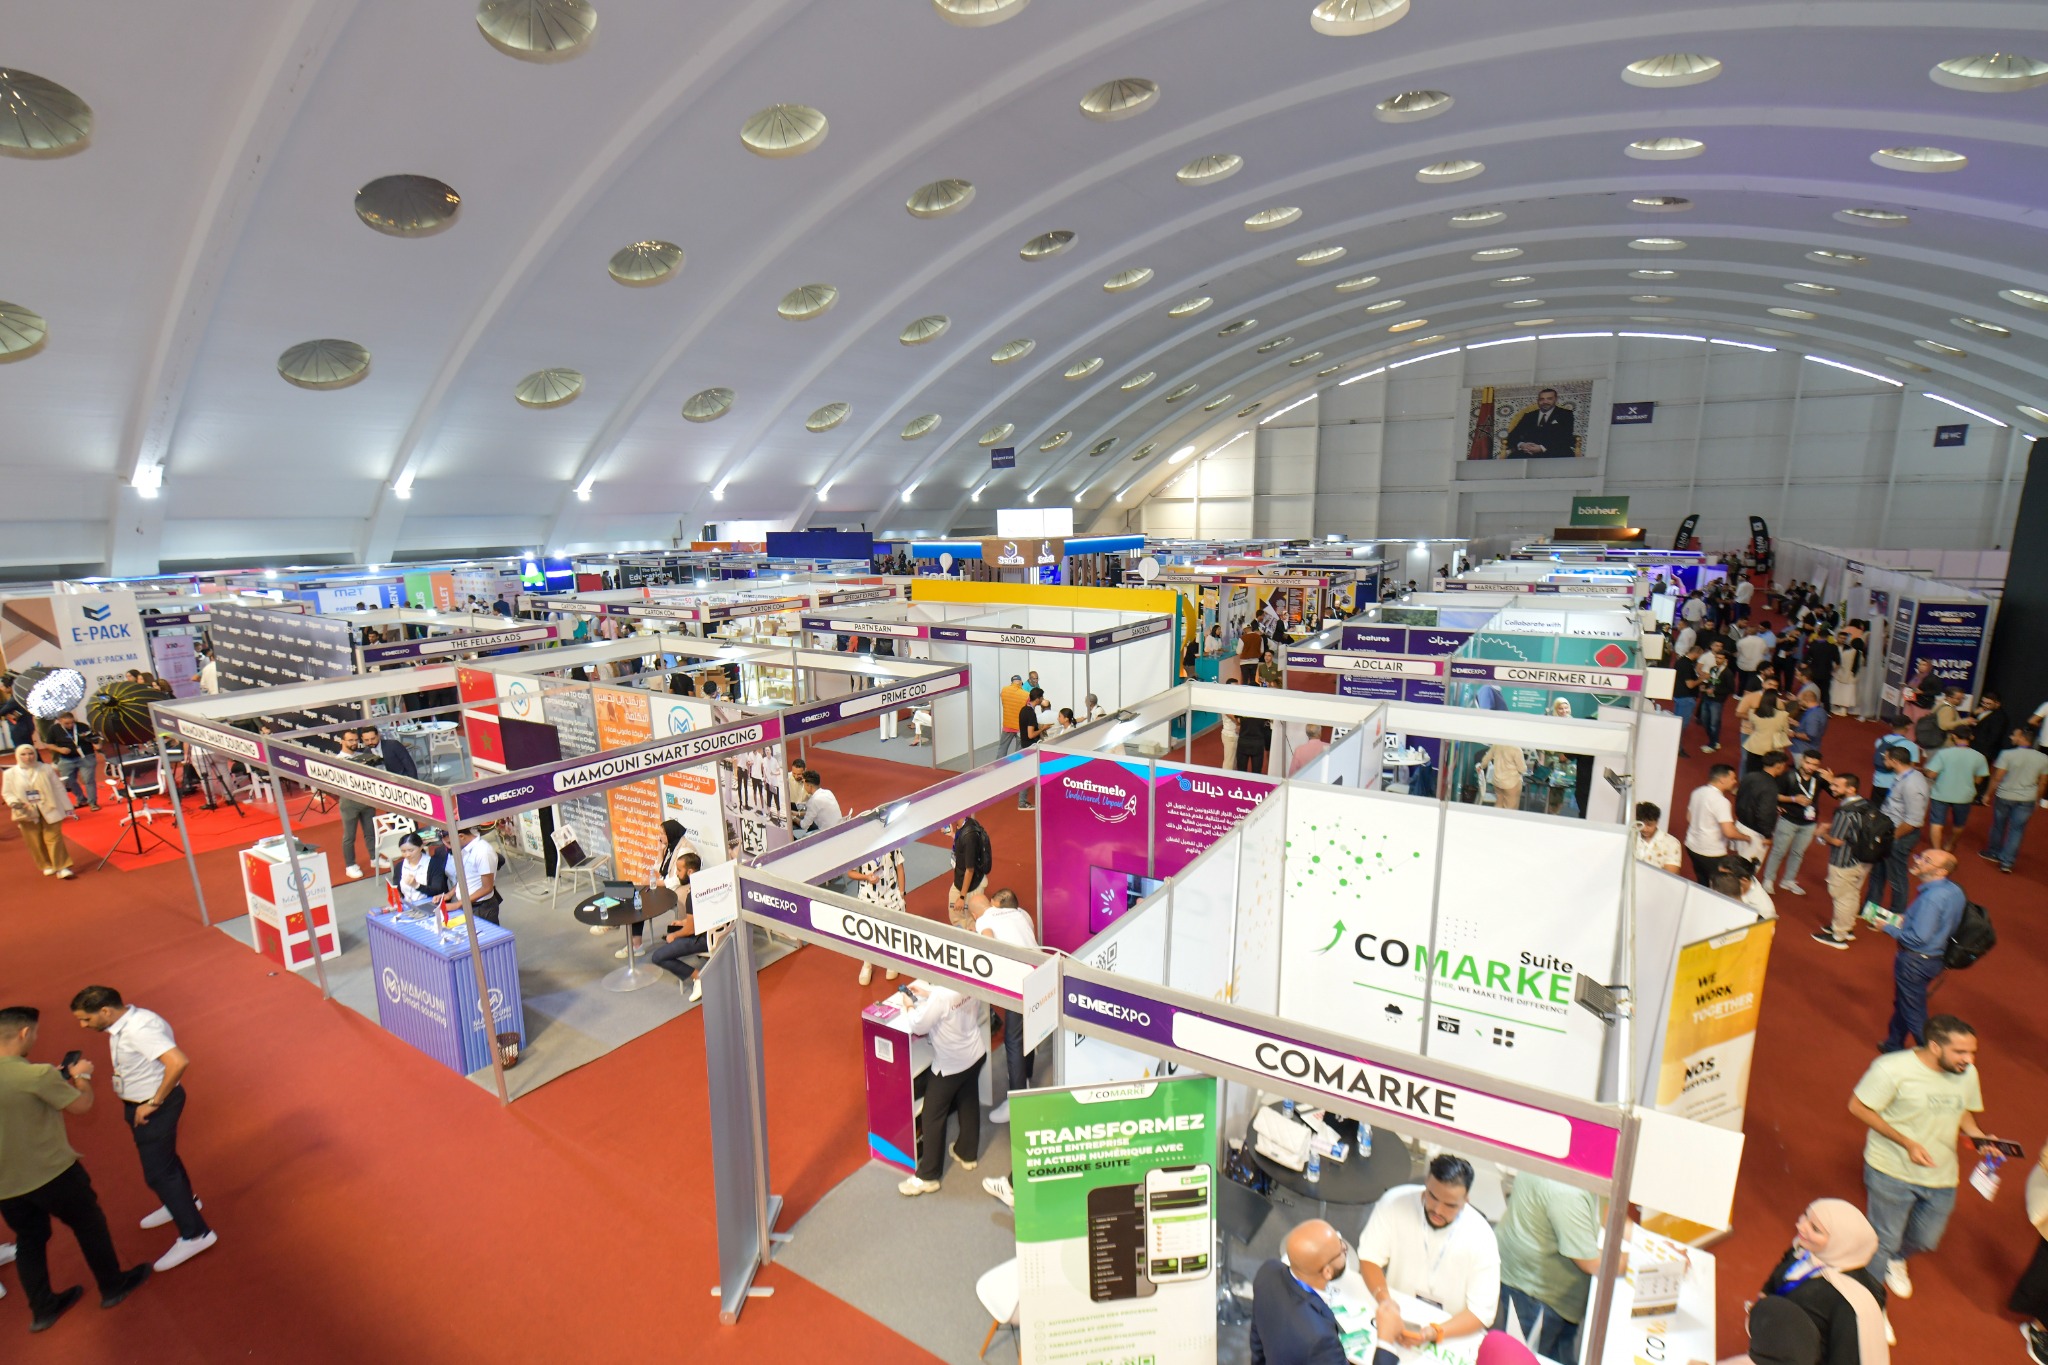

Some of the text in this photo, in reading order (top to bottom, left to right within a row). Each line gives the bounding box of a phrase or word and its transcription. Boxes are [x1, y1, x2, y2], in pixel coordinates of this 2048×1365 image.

[750, 605, 772, 613] CARTON
[72, 623, 131, 642] E-PACK
[471, 635, 501, 647] FELLAS
[504, 633, 521, 642] ADS
[1000, 634, 1036, 644] SANDBOX
[1357, 634, 1390, 642] Features
[1353, 660, 1403, 671] ADCLAIR
[1508, 669, 1586, 684] CONFIRMER
[1591, 674, 1612, 687] LIA
[881, 688, 907, 704] PRIME
[909, 684, 927, 698] COD
[488, 728, 757, 803] EMECEXPO MAMOUNI SMART SOURCING
[309, 764, 427, 811] MAMOUNI SMART SOURCING
[1063, 777, 1127, 798] Confirmelo
[1192, 780, 1224, 798] ديالنا
[695, 883, 728, 899] Confirmelo
[753, 891, 994, 979] EMECEXPO CONFIRMELO
[1354, 933, 1573, 1005] COMARKE
[1520, 951, 1574, 974] Suite
[1698, 972, 1717, 988] WE
[400, 978, 446, 1014] MAMOUNI
[1458, 985, 1470, 993] WE
[1472, 988, 1497, 1000] MAKE
[1499, 994, 1515, 1004] THE
[1516, 999, 1569, 1016] DIFFERENCE
[1696, 984, 1733, 1006] WORK
[1693, 992, 1754, 1025] TOGETHER
[1078, 994, 1456, 1122] EMECEXPO COMARKE
[1684, 1057, 1716, 1082] NOS
[1096, 1088, 1146, 1099] COMARKE
[1025, 1114, 1205, 1147] TRANSFORMEZ
[1026, 1137, 1130, 1157] VOTRE ENTREPRISE
[1027, 1143, 1184, 1167] EN ACTEUR NUMÉRIQUE AVEC
[1027, 1158, 1131, 1178] COMARKE SUITE
